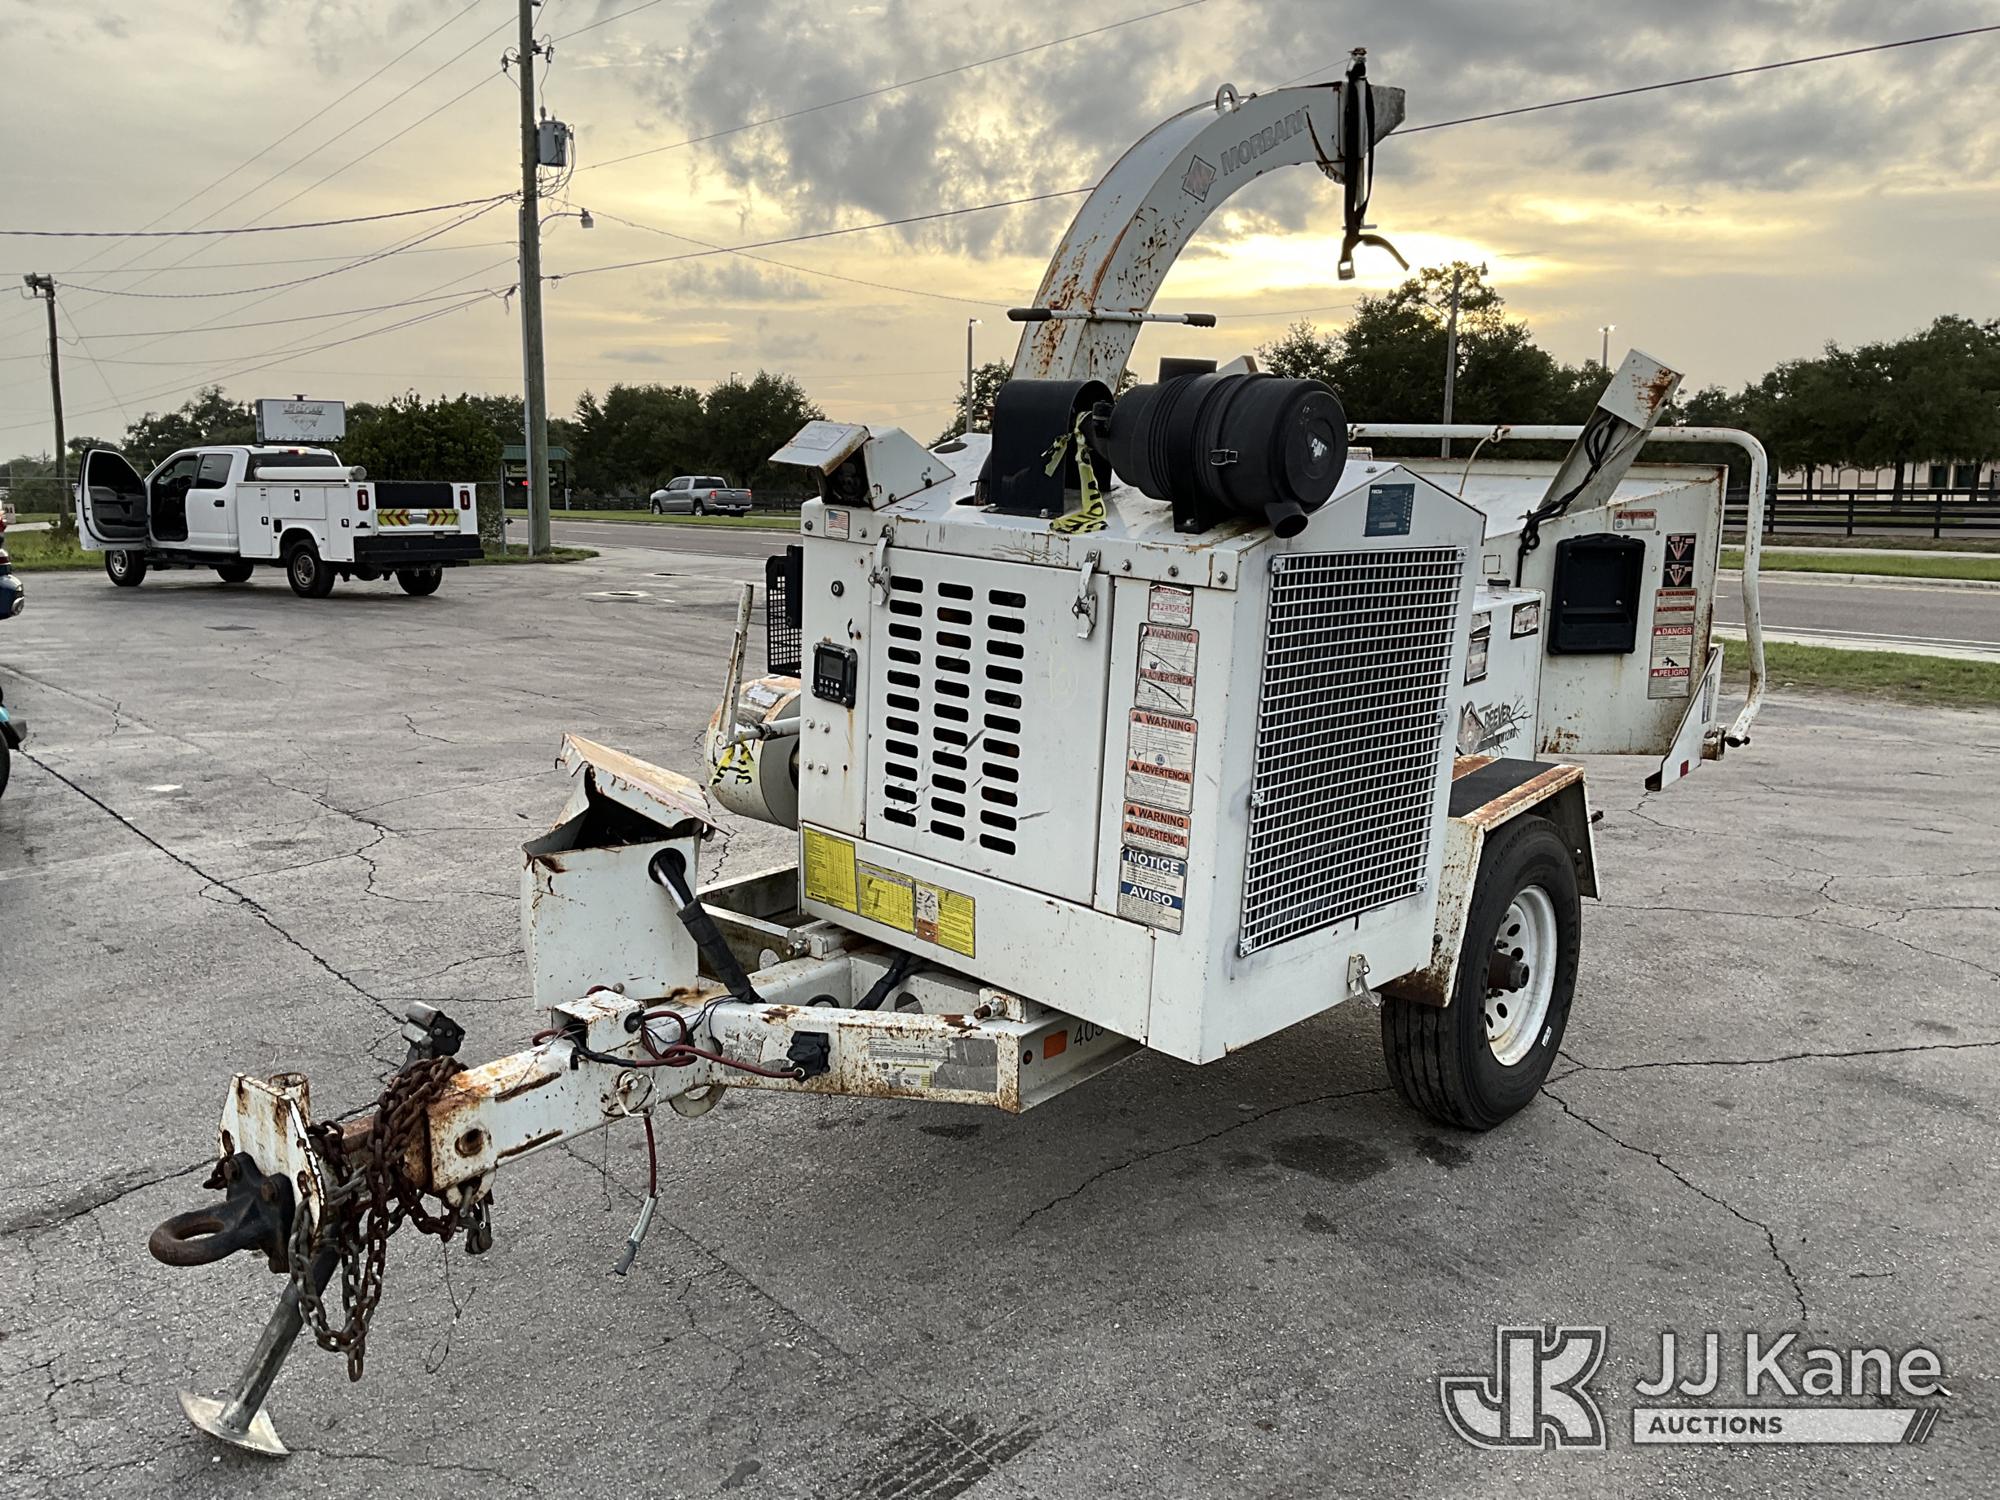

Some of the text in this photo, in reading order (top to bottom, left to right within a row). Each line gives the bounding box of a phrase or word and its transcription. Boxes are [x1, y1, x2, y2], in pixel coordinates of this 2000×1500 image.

[1151, 628, 1193, 642] WARNING
[1662, 627, 1692, 635] DANGER
[1658, 669, 1688, 677] PELIGRO
[1145, 712, 1192, 732] WARNING
[1140, 764, 1190, 782] ADVERTENCIA
[1138, 807, 1184, 828] WARNING
[1135, 826, 1185, 846] ADVERTENCIA
[1128, 851, 1179, 874] NOTICE
[1129, 886, 1173, 906] AVISO
